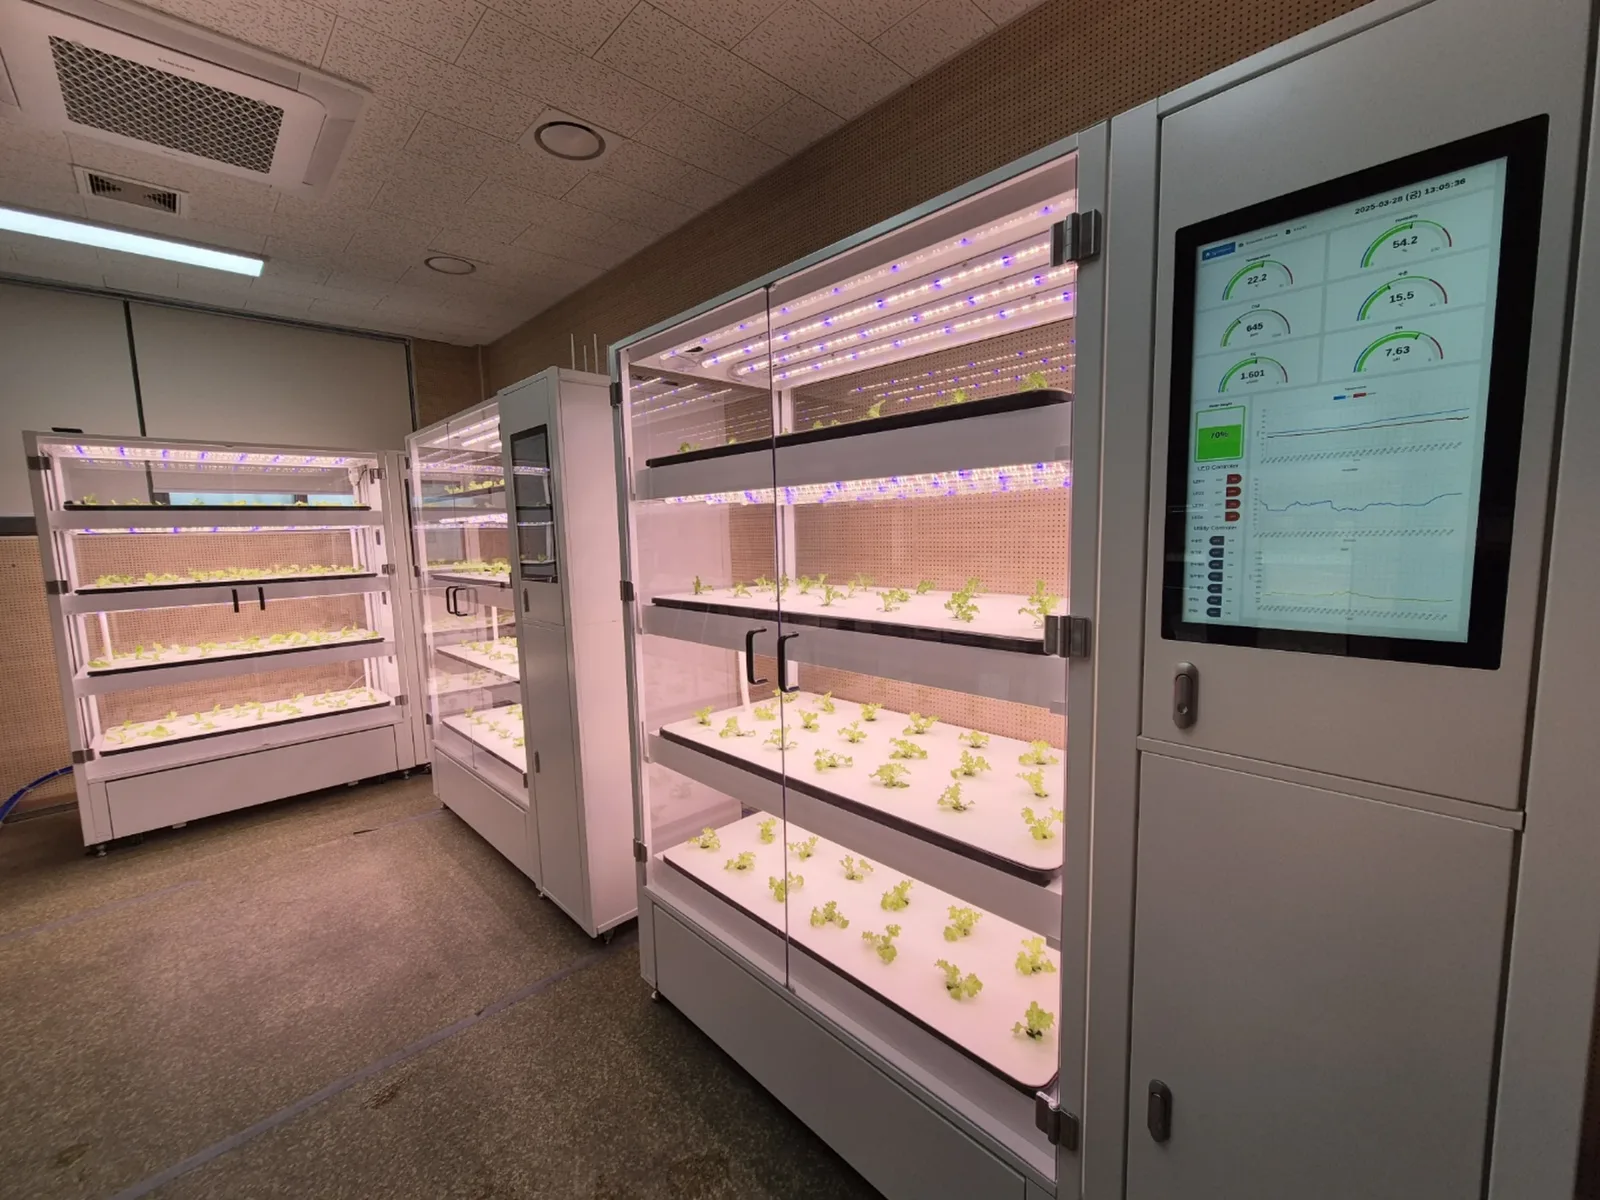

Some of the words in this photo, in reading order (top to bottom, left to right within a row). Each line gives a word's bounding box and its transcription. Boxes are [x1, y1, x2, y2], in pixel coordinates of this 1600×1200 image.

[1392, 235, 1418, 249] 54.2
[1247, 273, 1268, 285] 22.2
[1389, 290, 1415, 304] 15.5
[1246, 321, 1264, 332] 645
[1385, 345, 1410, 357] 7.63
[1240, 369, 1265, 380] 1.601
